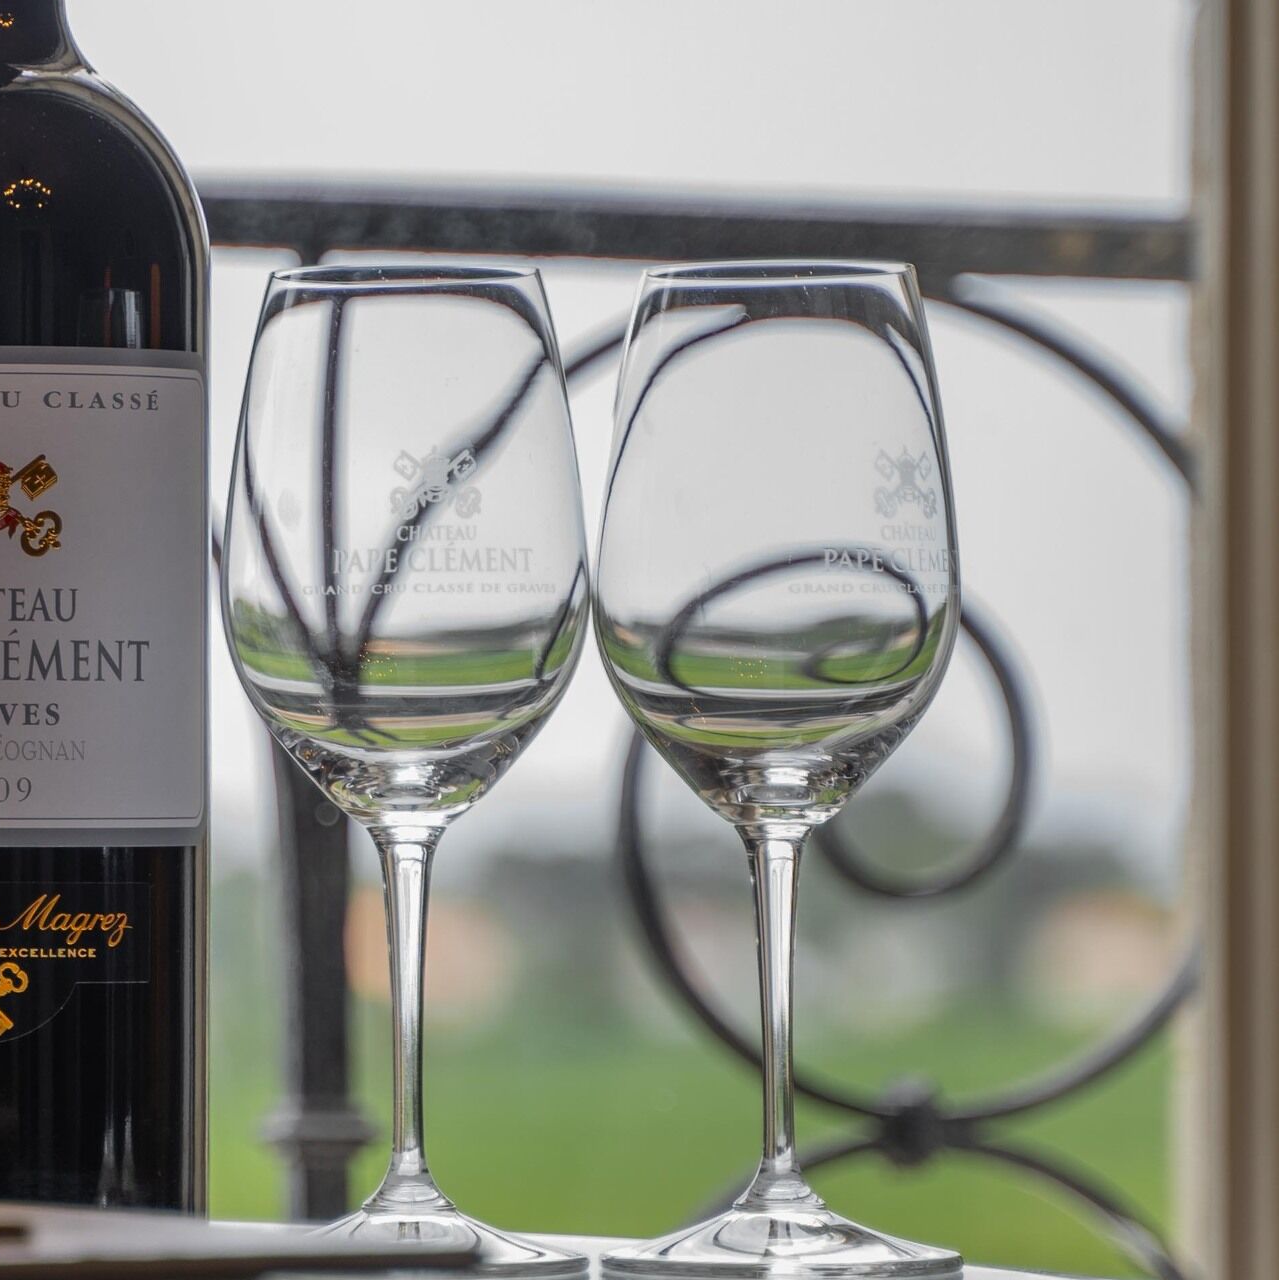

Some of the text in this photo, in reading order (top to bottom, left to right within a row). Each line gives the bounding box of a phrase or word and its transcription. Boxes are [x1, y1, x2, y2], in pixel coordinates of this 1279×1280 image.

[43, 389, 160, 411] CLASSÉ
[333, 542, 534, 574] PAPE CLÉMENT
[823, 547, 885, 573] PAPE
[371, 583, 407, 595] CRU
[481, 583, 501, 593] DE
[507, 582, 557, 594] GRAVES
[788, 583, 855, 594] GRAND
